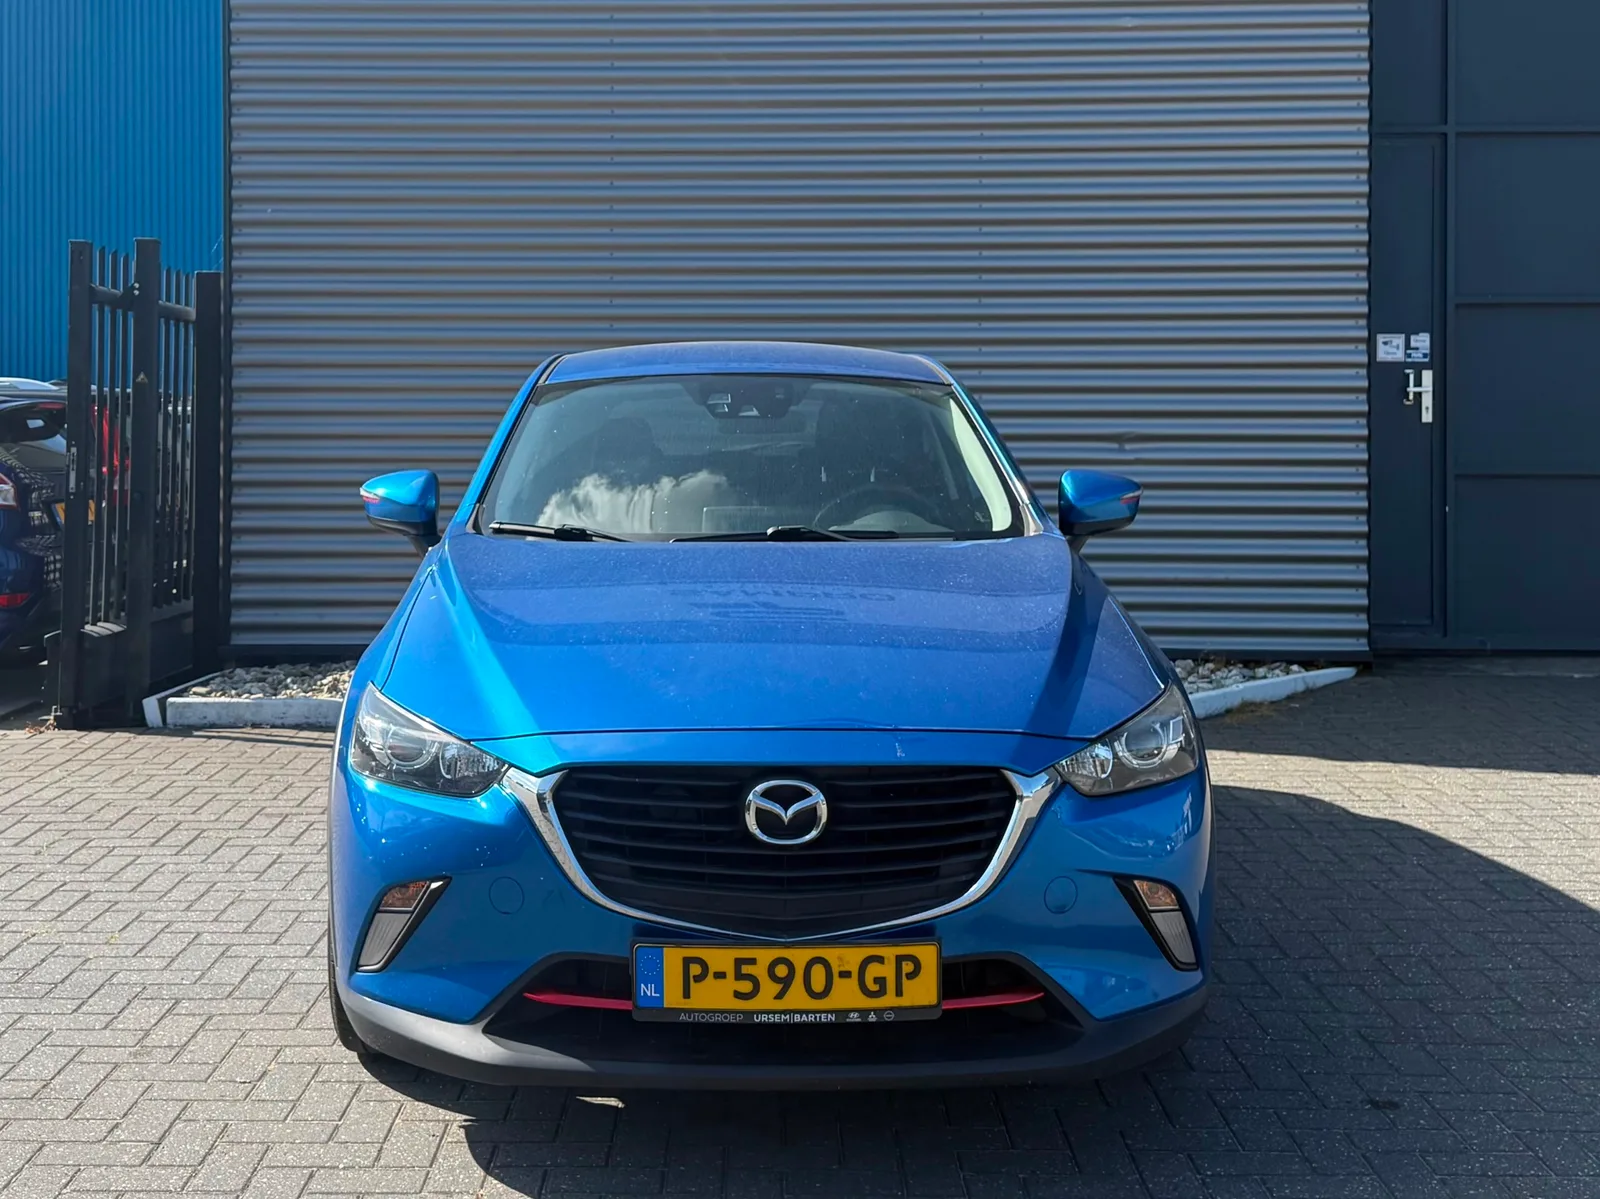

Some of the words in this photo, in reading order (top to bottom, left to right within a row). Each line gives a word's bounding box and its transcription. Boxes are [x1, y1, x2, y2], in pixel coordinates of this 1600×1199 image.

[681, 954, 922, 1001] P-590-GP
[640, 983, 660, 997] NL
[679, 1012, 744, 1022] AUTOGROEP
